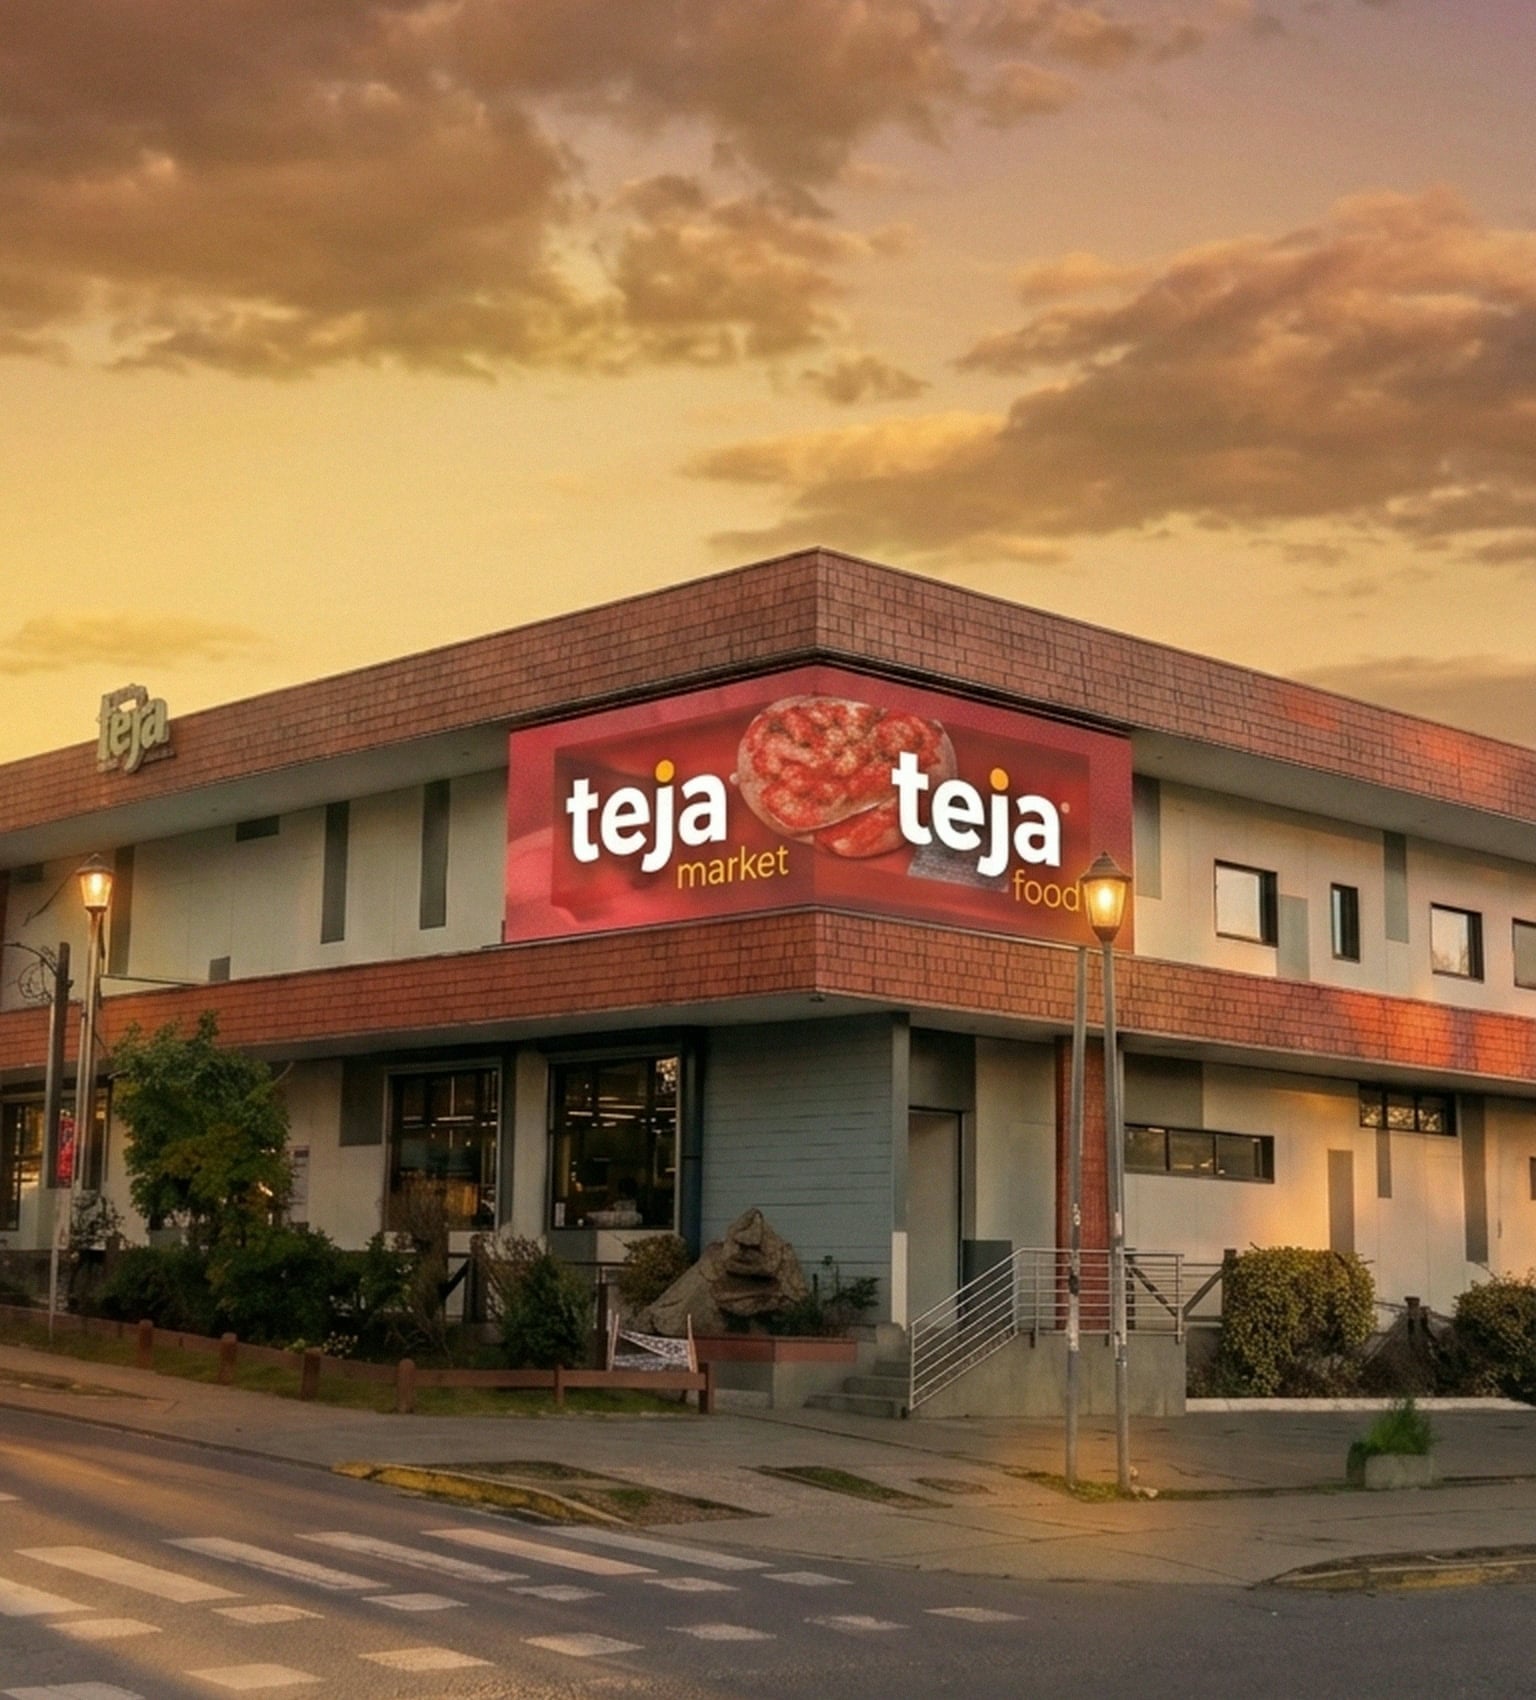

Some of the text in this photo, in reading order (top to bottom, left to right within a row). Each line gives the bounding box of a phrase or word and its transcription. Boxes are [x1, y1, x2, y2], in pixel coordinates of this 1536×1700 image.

[566, 760, 727, 873] teja
[891, 751, 1061, 877] teja
[677, 846, 789, 889] market
[1012, 869, 1081, 912] food
